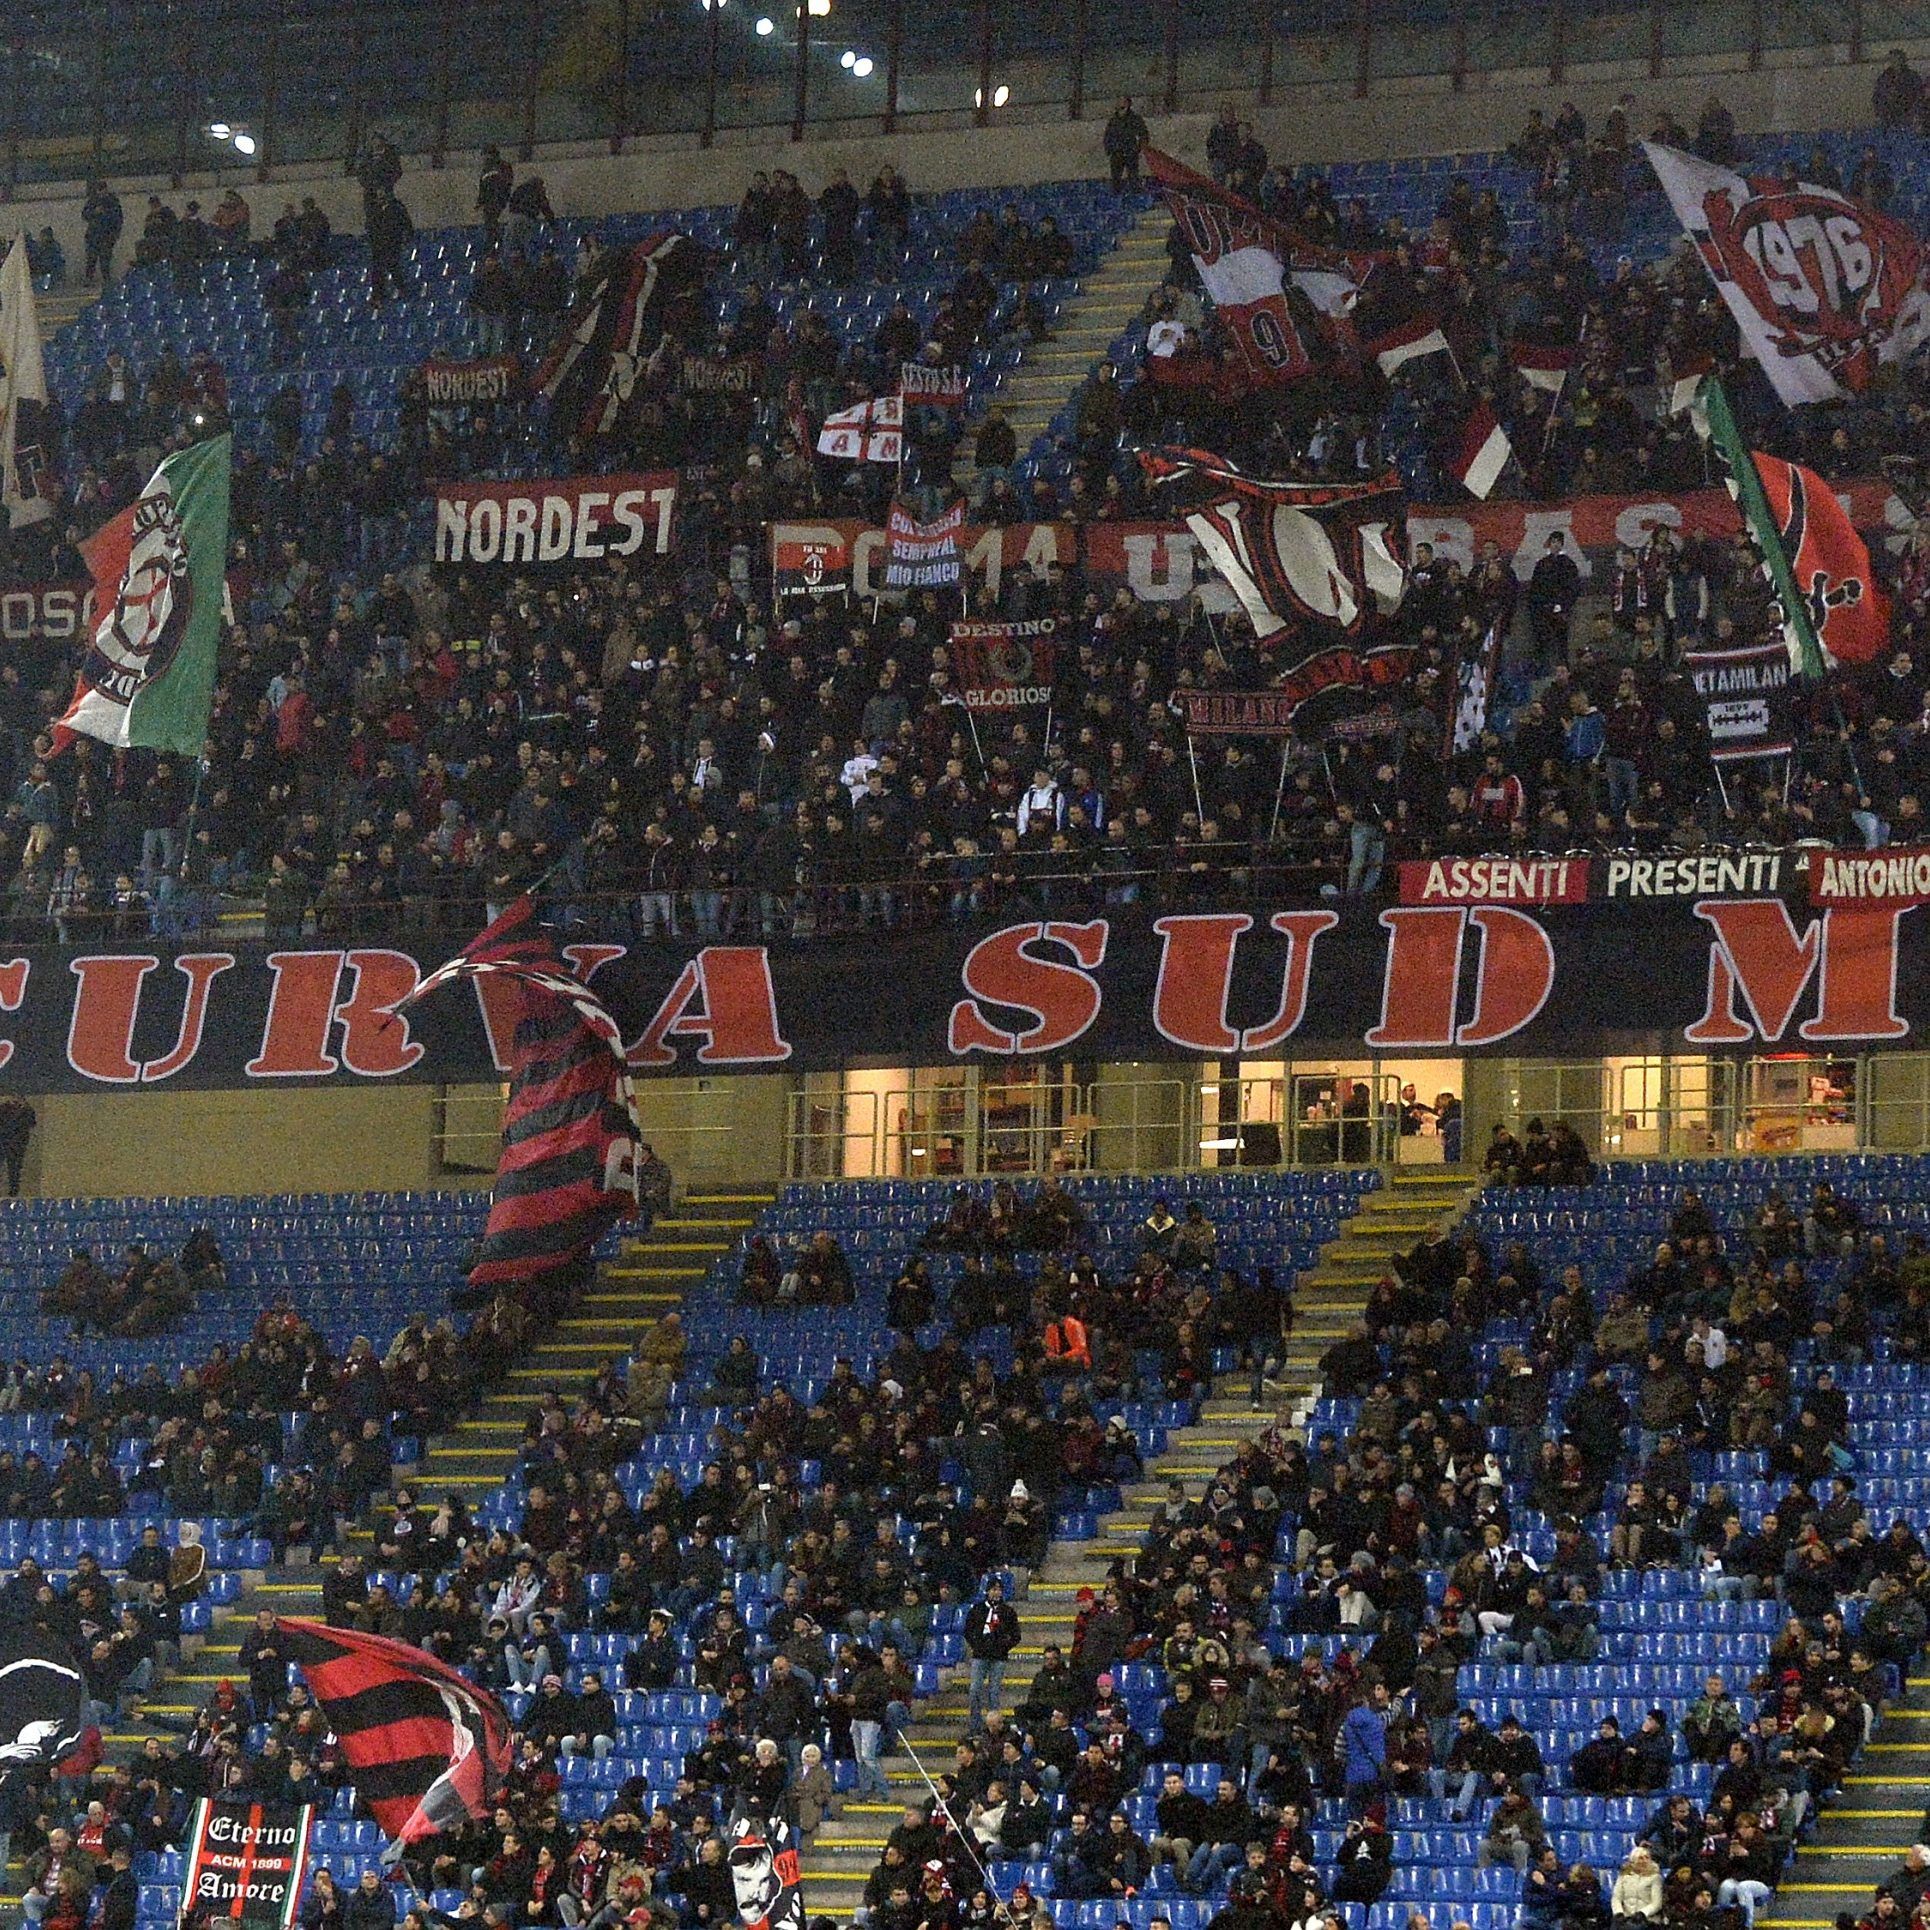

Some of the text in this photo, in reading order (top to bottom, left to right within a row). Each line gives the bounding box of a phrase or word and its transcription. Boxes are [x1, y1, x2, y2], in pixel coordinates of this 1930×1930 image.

[1743, 214, 1872, 313] 1976
[435, 488, 676, 563] NORDEST
[886, 561, 960, 586] MIO FIANCO
[952, 619, 1056, 637] DESTINO
[1422, 860, 1569, 899] ASSENTI
[1607, 854, 1781, 897] PRESENTI
[1819, 853, 1930, 898] ANTONIO
[948, 905, 1556, 1056] SUD
[208, 1816, 296, 1845] Eterno
[210, 1854, 283, 1870] ACM 1899
[197, 1871, 285, 1903] Amore
